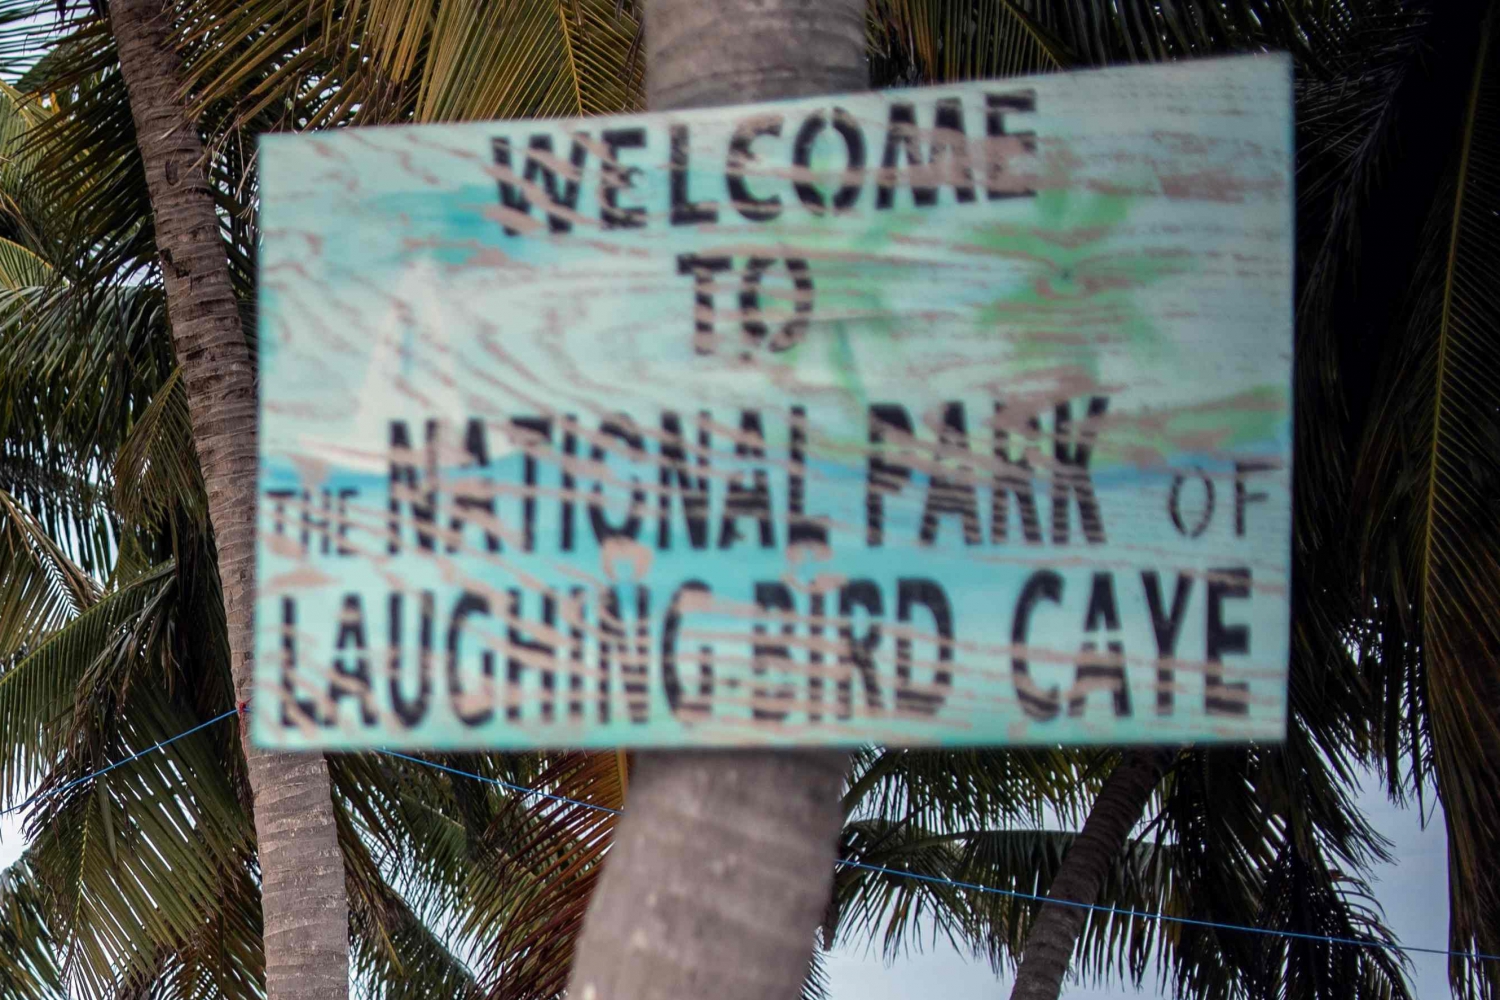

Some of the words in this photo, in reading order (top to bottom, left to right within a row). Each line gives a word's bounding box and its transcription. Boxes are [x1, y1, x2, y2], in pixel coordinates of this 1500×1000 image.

[491, 88, 1038, 236] WELCOME
[676, 253, 815, 356] TO
[266, 489, 358, 556] THE
[389, 409, 830, 555] NATIONAL
[866, 397, 1109, 547] PARK
[1169, 460, 1282, 538] OF
[282, 579, 713, 727] LAUGHING
[752, 577, 953, 722] BIRD
[1011, 567, 1252, 723] CAYE
